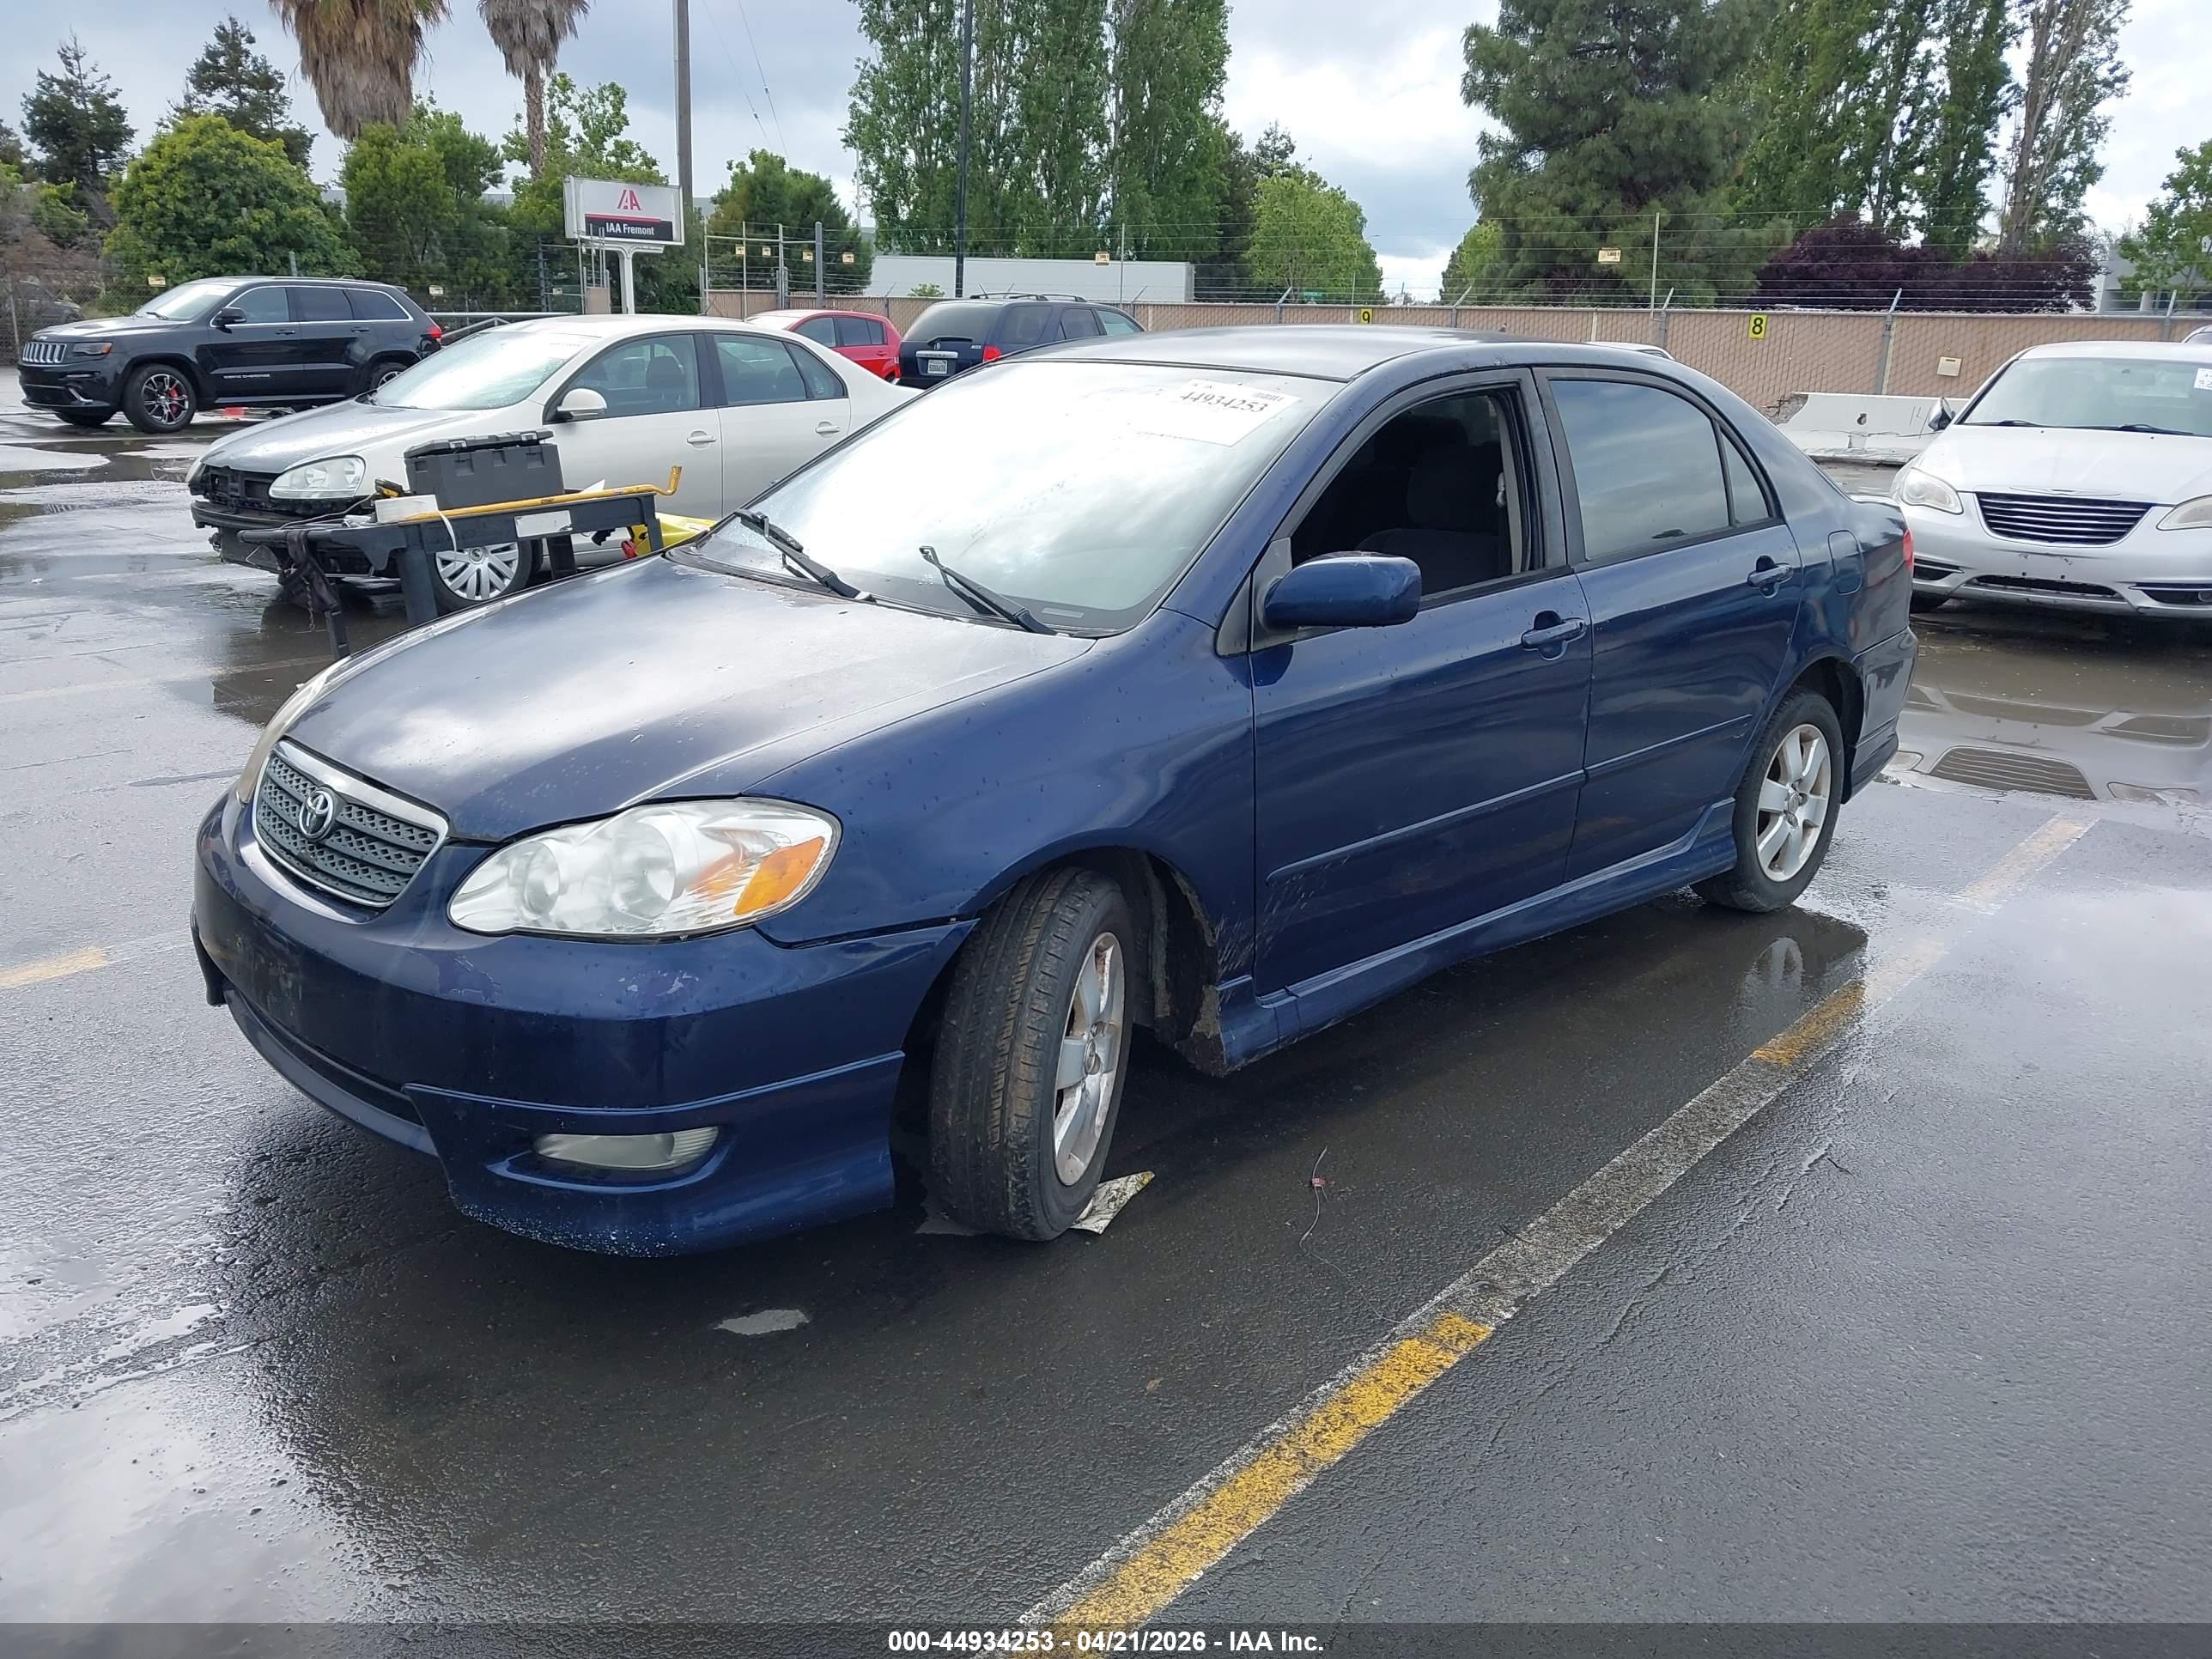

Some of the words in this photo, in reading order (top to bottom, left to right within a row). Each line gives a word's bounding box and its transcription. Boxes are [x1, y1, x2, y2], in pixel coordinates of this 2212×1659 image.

[606, 222, 622, 234] IAA
[623, 223, 654, 235] Fremont
[1362, 311, 1370, 324] 9
[1752, 317, 1764, 335] 8
[1180, 392, 1268, 412] 44934253
